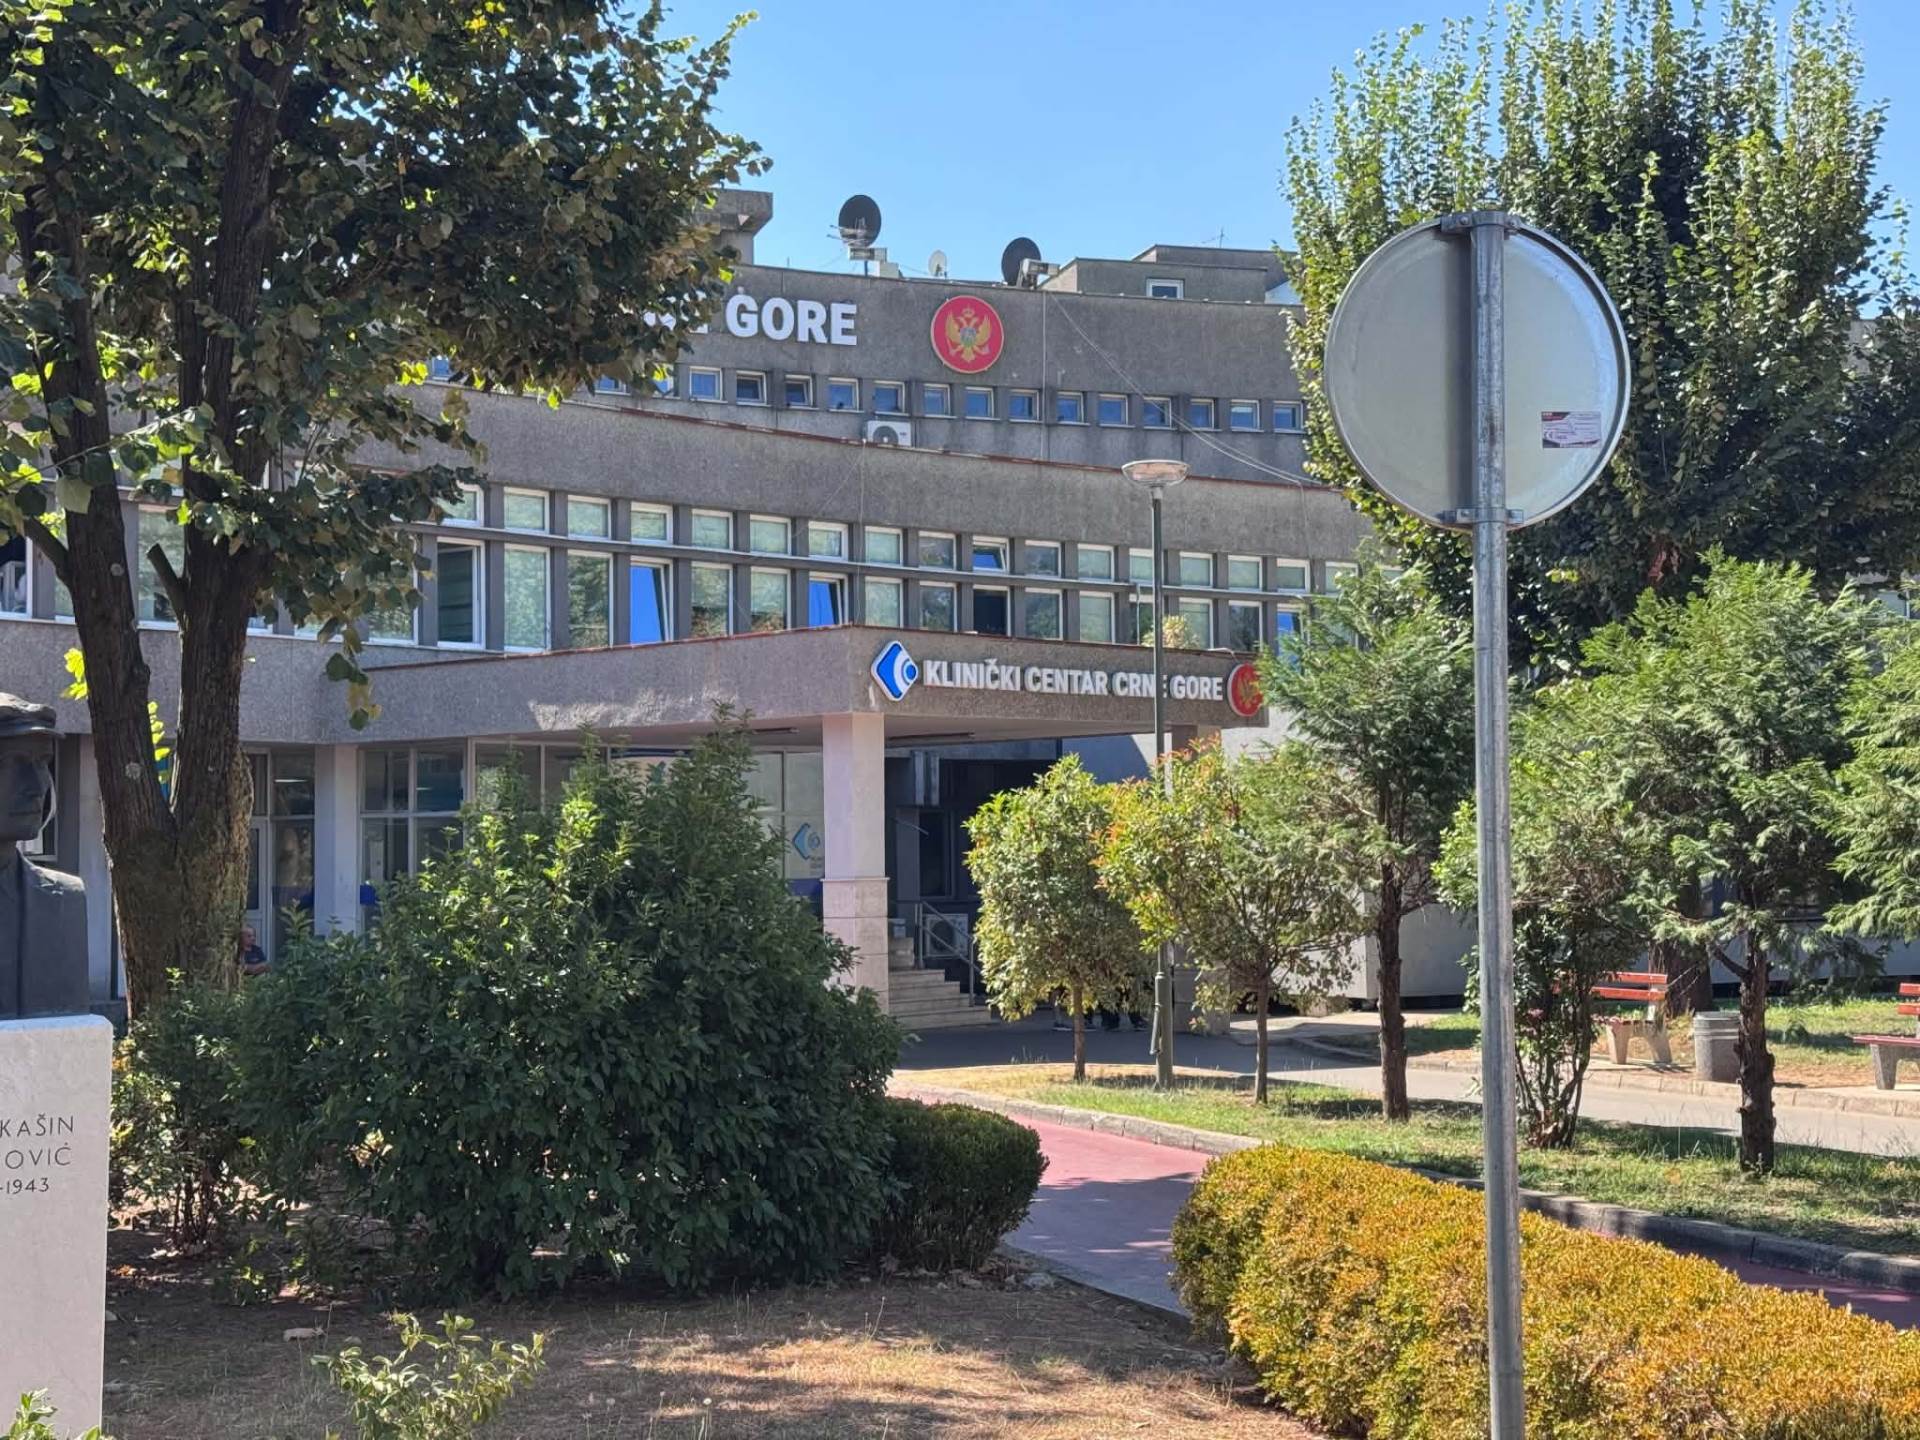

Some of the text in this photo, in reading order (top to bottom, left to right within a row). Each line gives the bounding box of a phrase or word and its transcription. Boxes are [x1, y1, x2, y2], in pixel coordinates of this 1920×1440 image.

[725, 294, 858, 346] GORE
[923, 658, 1021, 692] KLINIČKI
[1024, 666, 1108, 696] CENTAR
[1169, 675, 1224, 701] GORE
